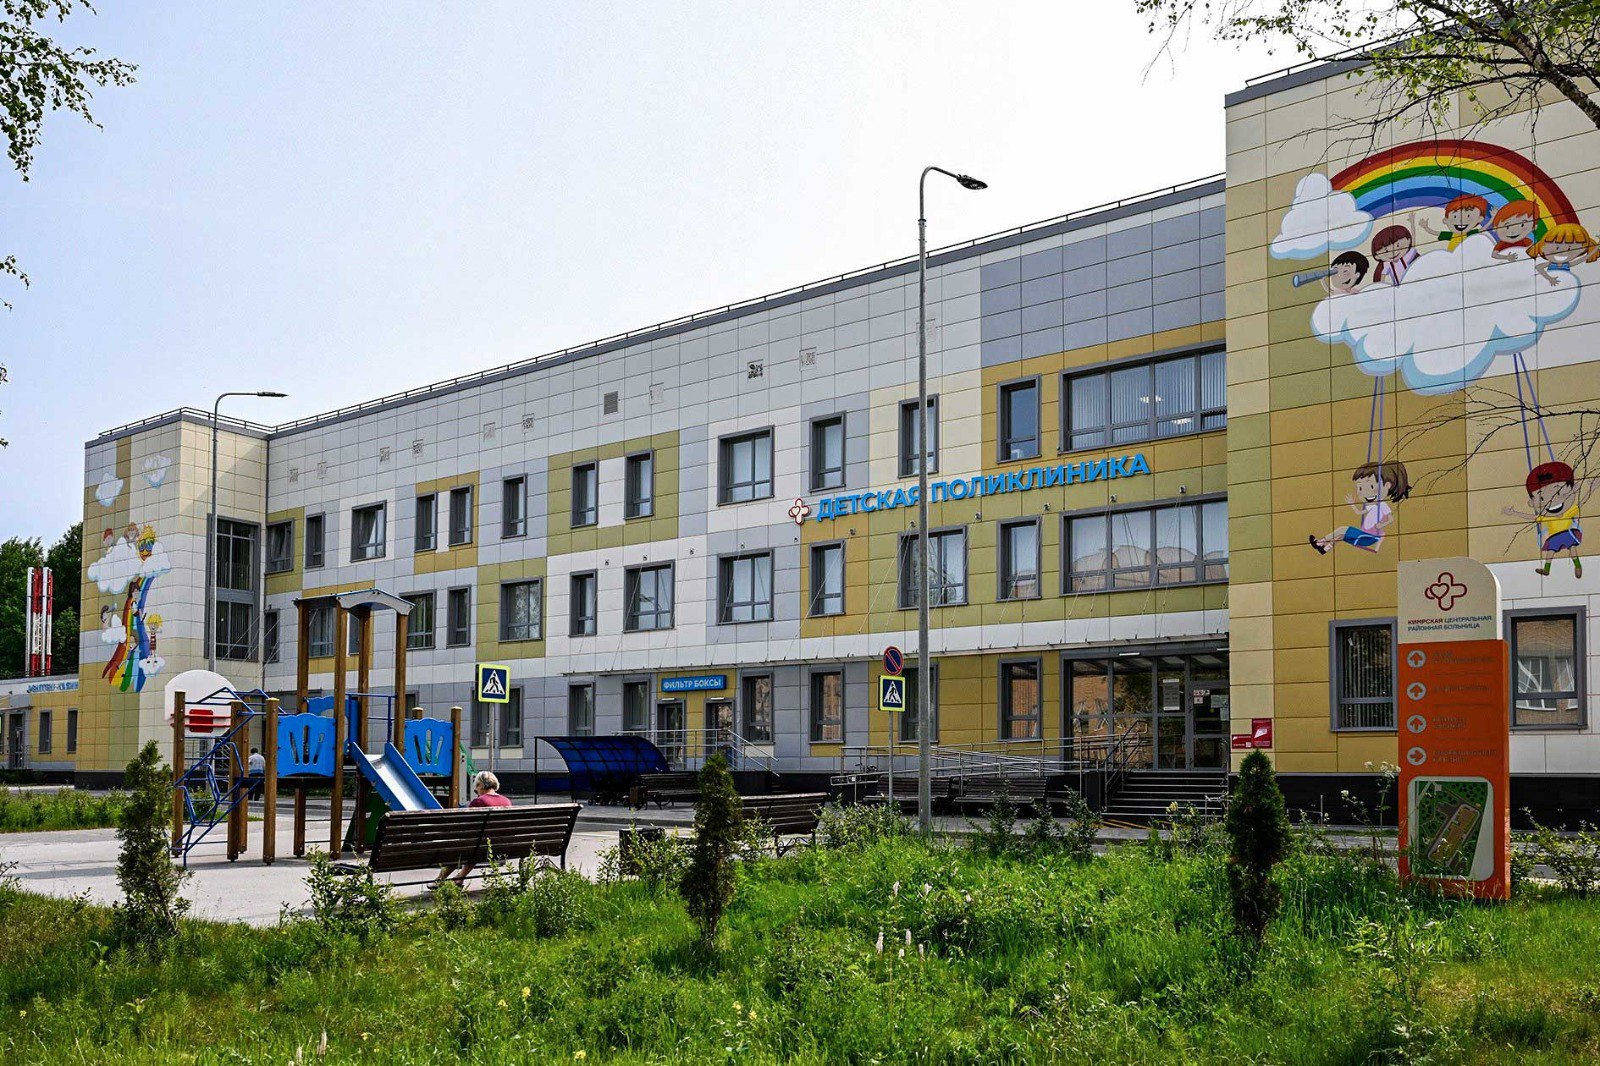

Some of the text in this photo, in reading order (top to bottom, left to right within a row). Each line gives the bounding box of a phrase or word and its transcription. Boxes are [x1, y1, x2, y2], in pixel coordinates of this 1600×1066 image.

[816, 453, 1150, 522] ДЕТСКАЯ ПОЛИКЛИНИКА
[663, 679, 721, 689] ФИЛЬТР БОКСЫ
